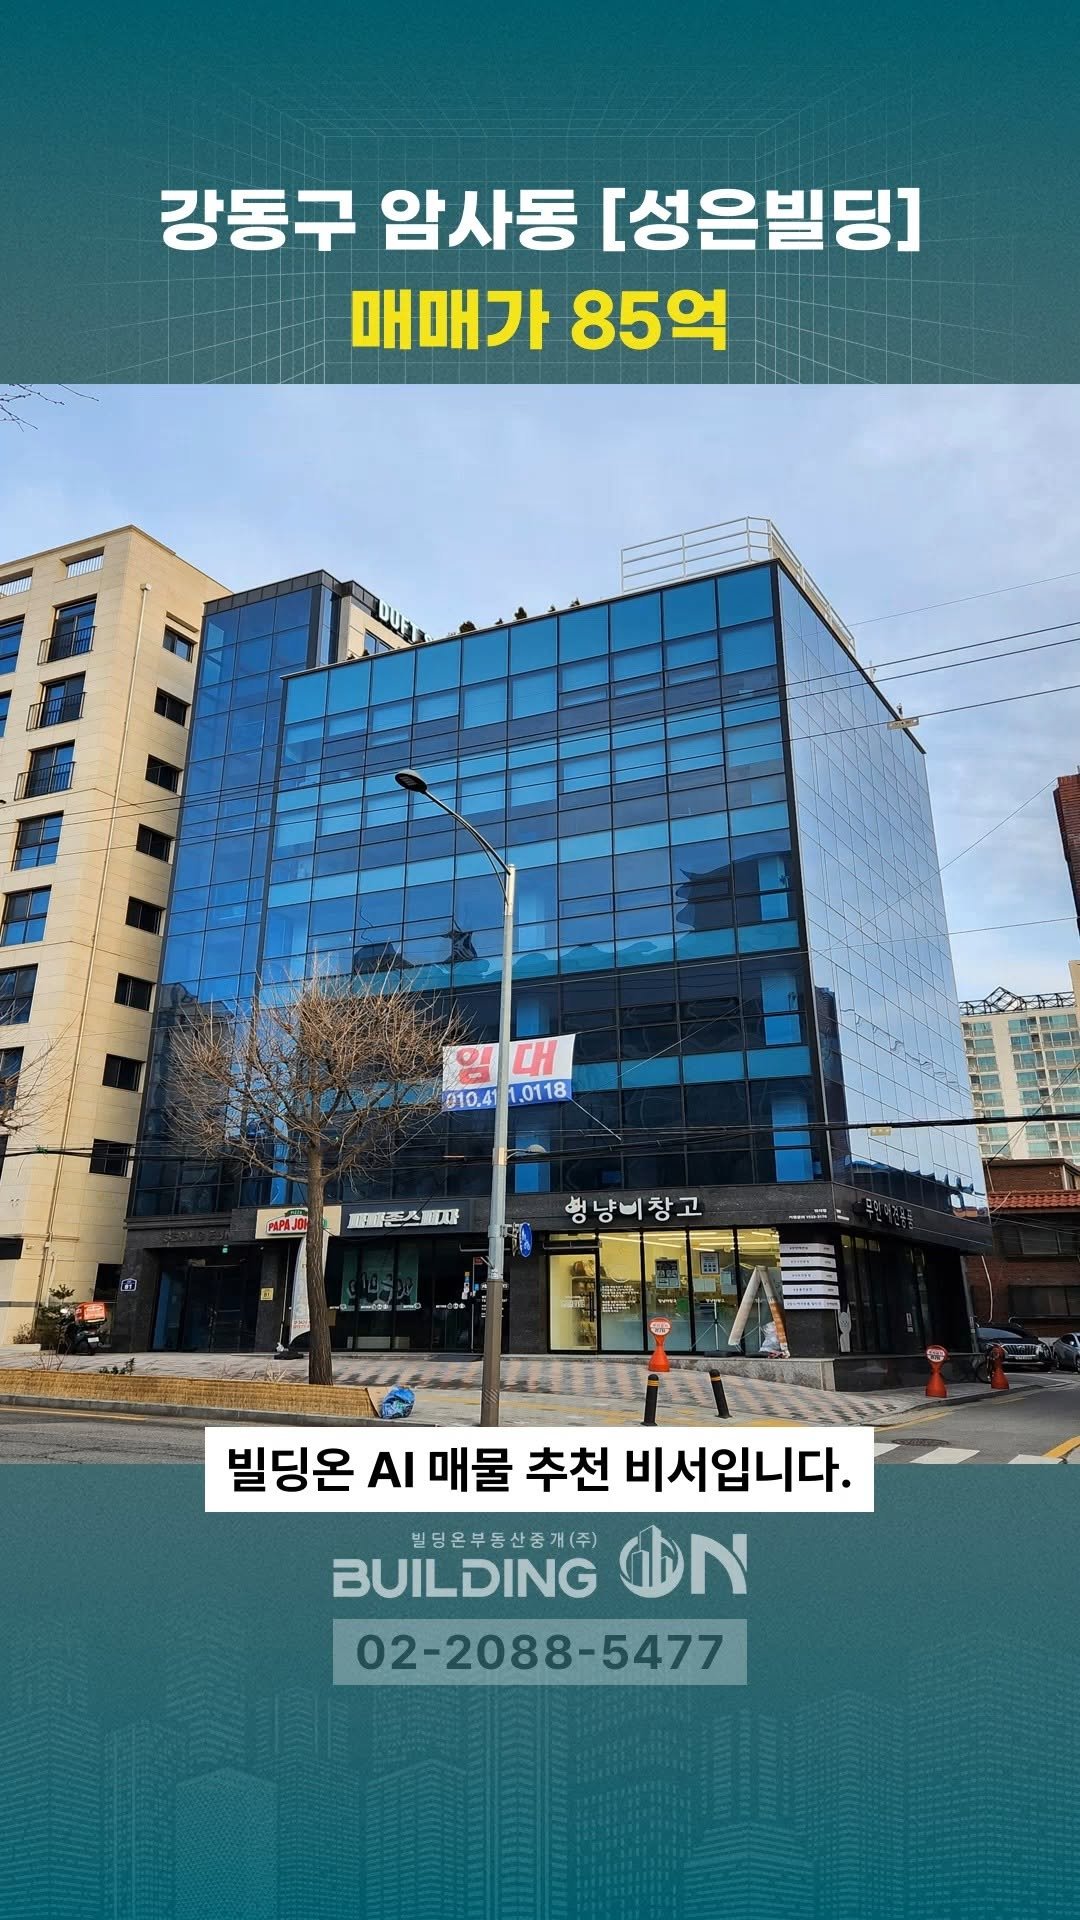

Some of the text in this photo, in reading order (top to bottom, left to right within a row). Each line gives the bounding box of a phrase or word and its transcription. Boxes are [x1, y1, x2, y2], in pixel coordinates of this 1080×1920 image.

[445, 1081, 567, 1109] 010.411.0118
[268, 1218, 290, 1232] PAPA
[346, 1208, 460, 1229] 파파존스피자
